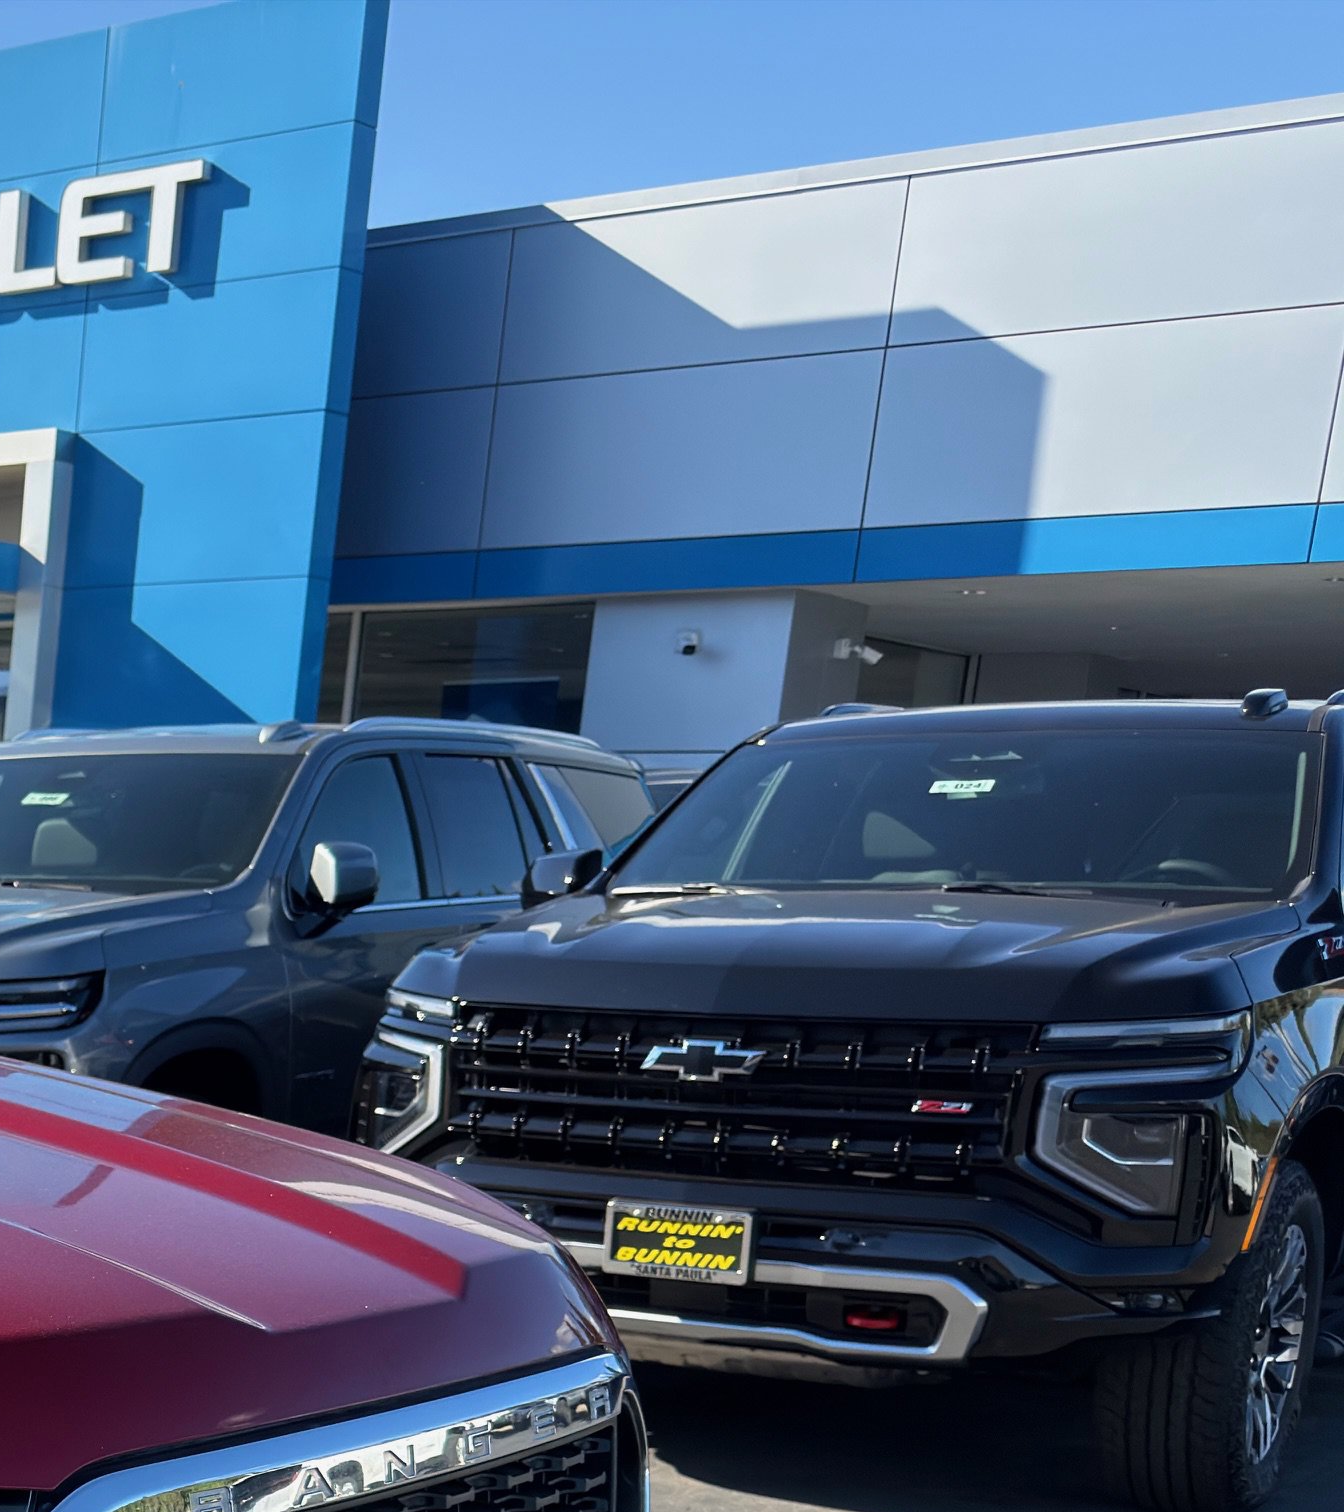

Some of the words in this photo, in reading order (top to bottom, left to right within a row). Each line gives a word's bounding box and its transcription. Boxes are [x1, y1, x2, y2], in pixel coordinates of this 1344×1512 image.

[644, 1207, 714, 1223] BUNNIN
[616, 1216, 744, 1240] RUNNIN'
[662, 1235, 696, 1249] to
[615, 1246, 736, 1271] BUNNIN
